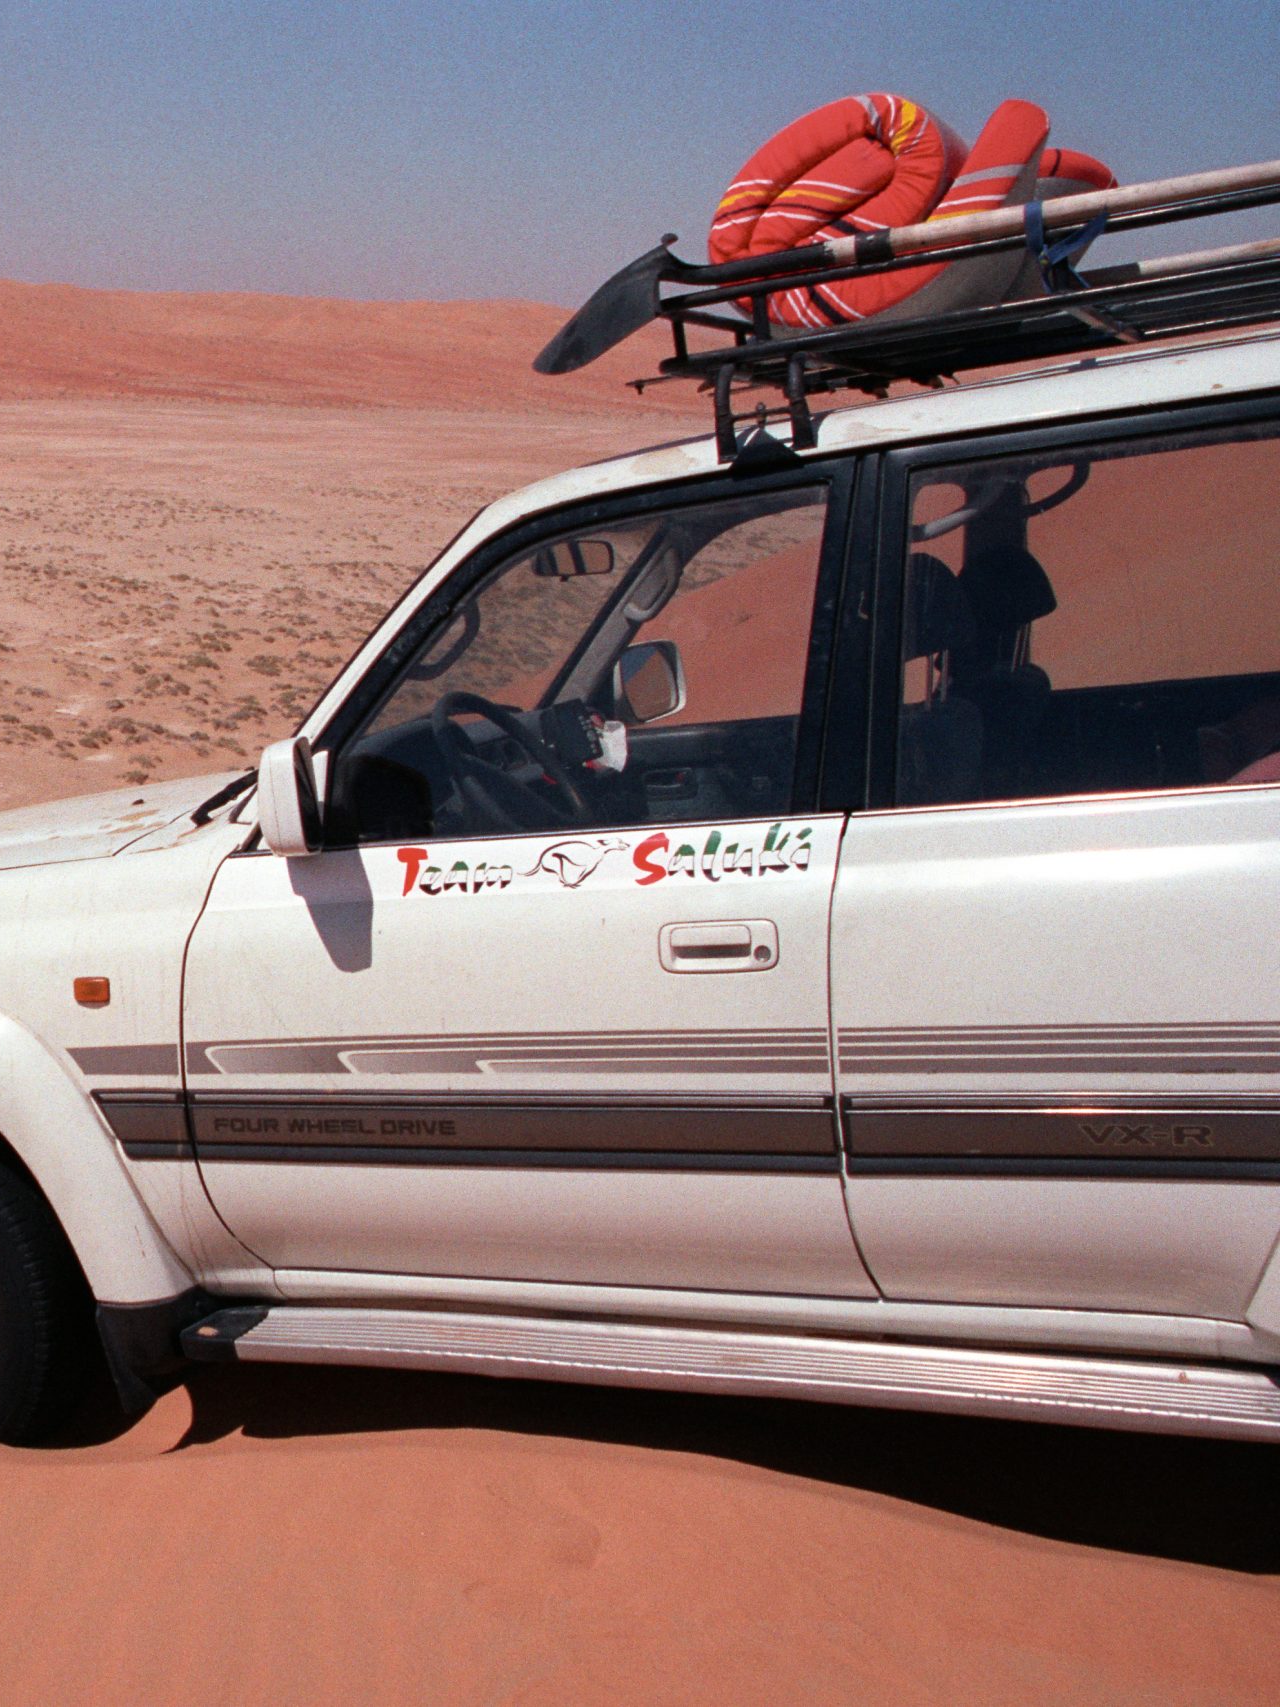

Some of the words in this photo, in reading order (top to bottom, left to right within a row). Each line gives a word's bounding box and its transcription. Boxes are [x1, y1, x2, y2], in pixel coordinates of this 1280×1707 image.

[397, 848, 513, 897] Team
[633, 822, 813, 886] Saluki
[214, 1117, 279, 1133] FOUR
[287, 1118, 375, 1135] WHEEL
[380, 1119, 456, 1136] DRIVE
[1081, 1124, 1213, 1147] VX-R
